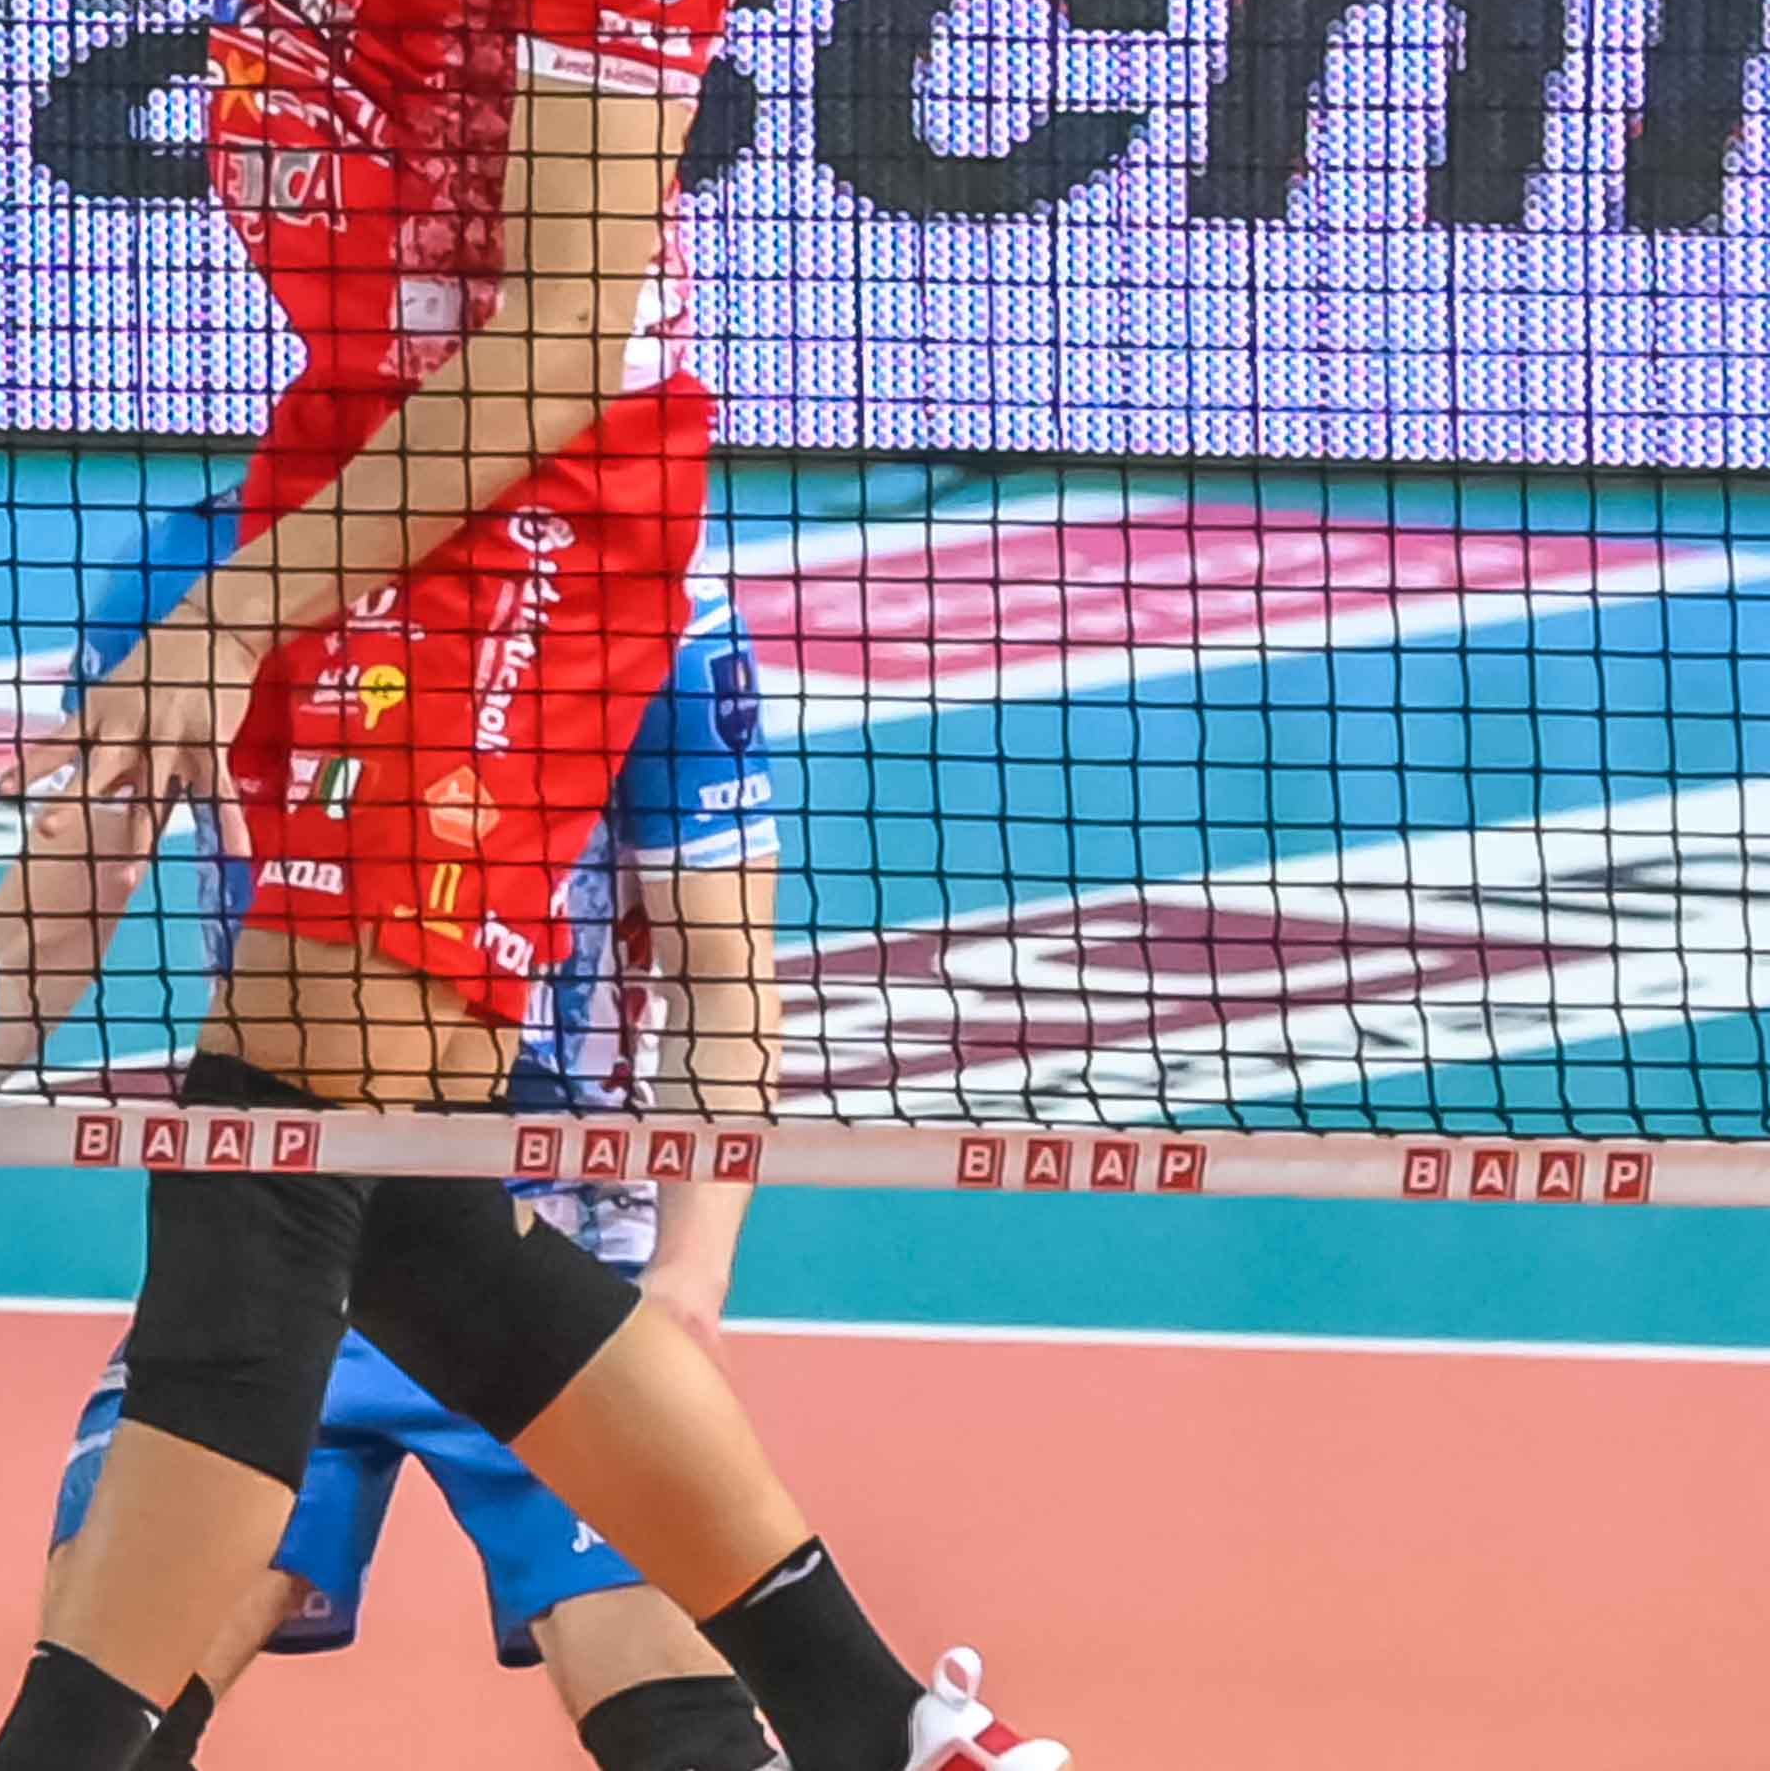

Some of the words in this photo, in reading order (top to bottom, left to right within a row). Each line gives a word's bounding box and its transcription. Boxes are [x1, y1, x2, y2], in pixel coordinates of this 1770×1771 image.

[77, 1119, 312, 1164] BAAP
[518, 1130, 755, 1176] BAAP
[961, 1142, 1199, 1187] BAAP
[1407, 1152, 1647, 1198] BAAP
